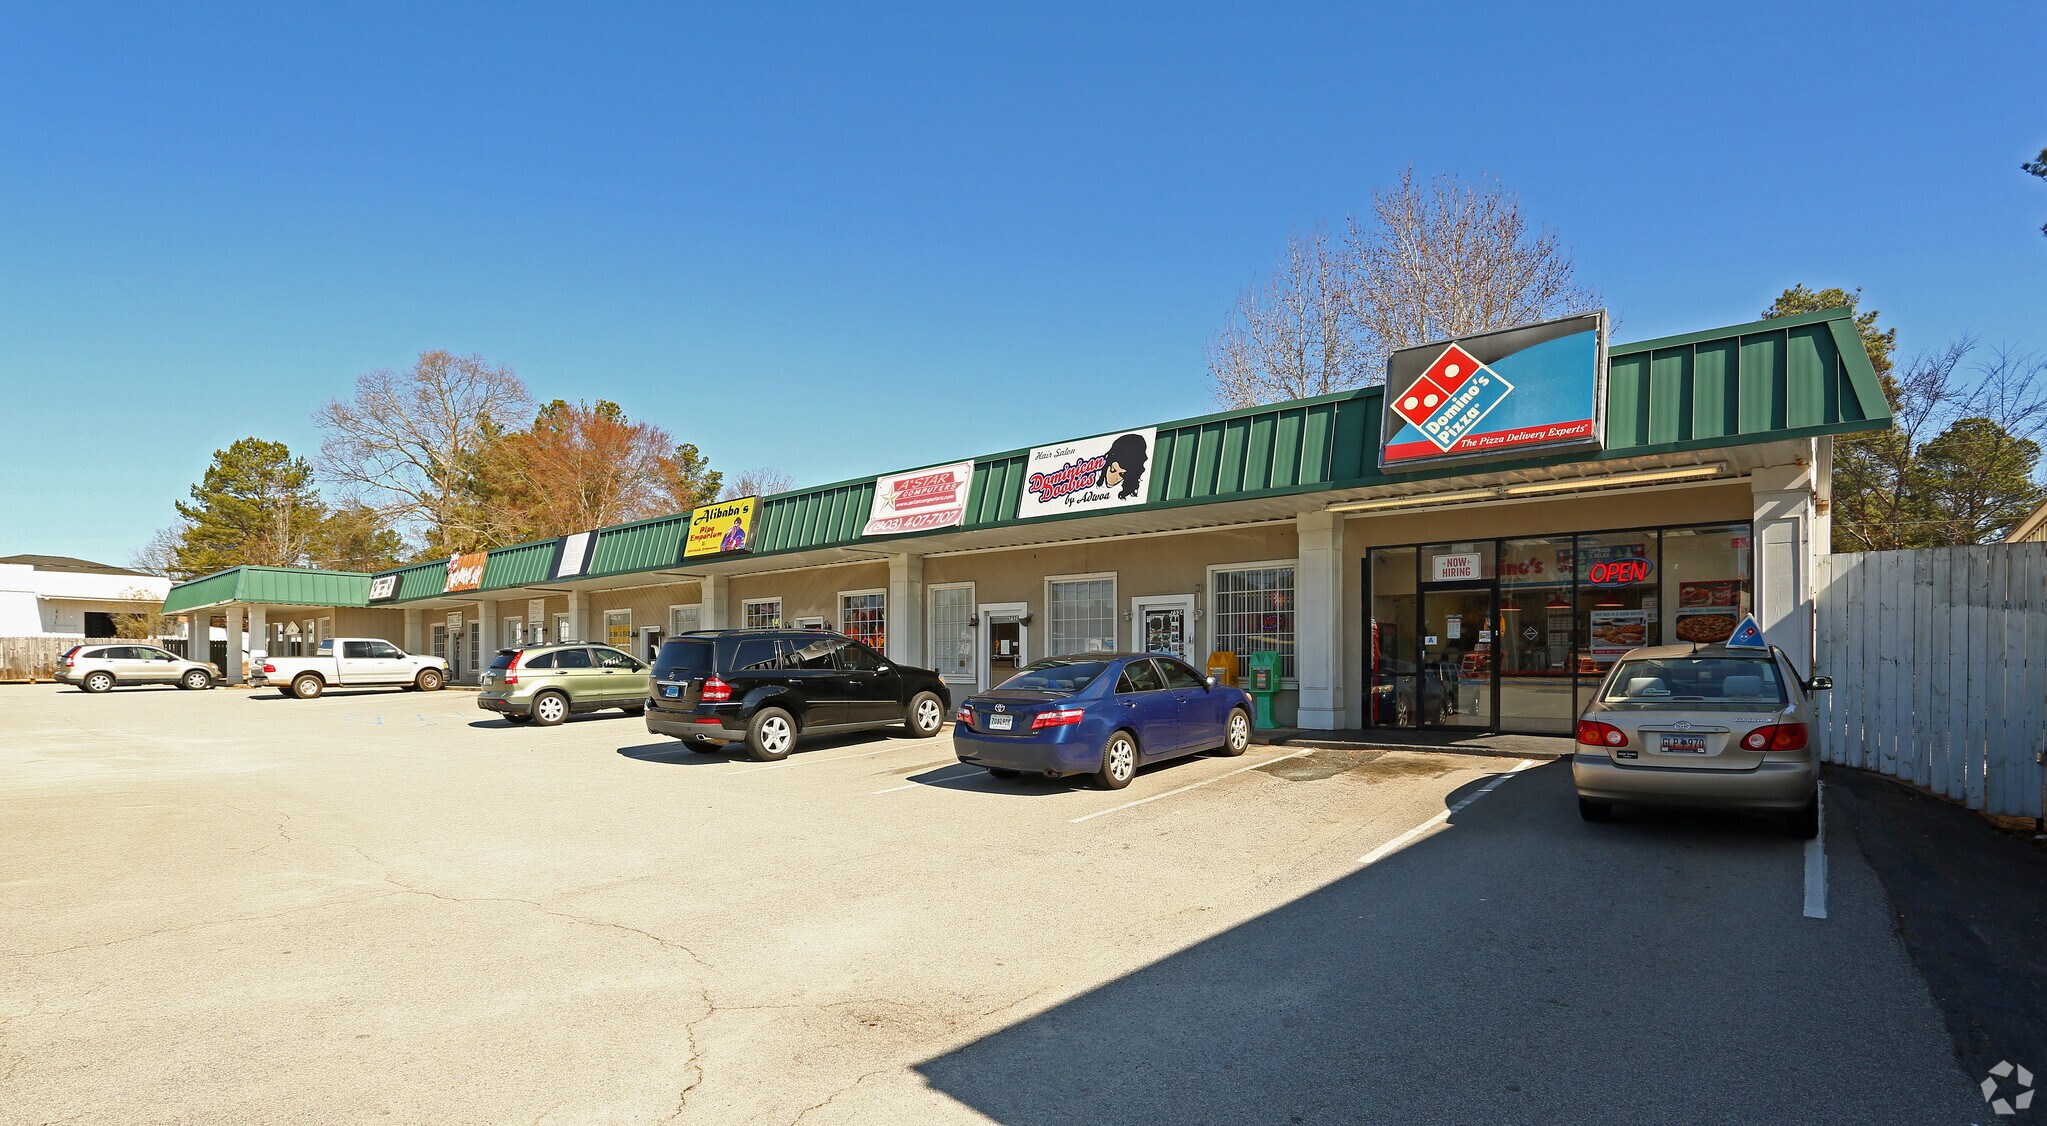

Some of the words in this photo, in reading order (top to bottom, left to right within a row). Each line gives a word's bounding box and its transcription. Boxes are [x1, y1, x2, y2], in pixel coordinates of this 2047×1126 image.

[1425, 376, 1490, 435] Domino's
[1460, 439, 1477, 448] The
[1479, 435, 1504, 446] Pizza
[1506, 430, 1545, 442] Delivery
[1547, 424, 1585, 437] Experts
[1035, 451, 1052, 460] Hair
[1053, 447, 1076, 458] Salon
[1029, 455, 1106, 493] Dominican
[902, 483, 957, 498] COMPUTERS
[1039, 472, 1096, 503] Doobies
[1065, 494, 1075, 507] by
[1076, 491, 1111, 504] Adwoa
[693, 502, 749, 526] Alibaba's
[869, 518, 903, 532] (803)
[903, 510, 959, 528] 407-7107
[690, 531, 722, 541] Emporium
[699, 526, 715, 534] Pipe
[1447, 558, 1467, 568] NOW
[1442, 567, 1471, 578] HIRING
[1589, 562, 1647, 583] OPEN
[1662, 737, 1679, 747] GLP
[1688, 738, 1705, 748] 970
